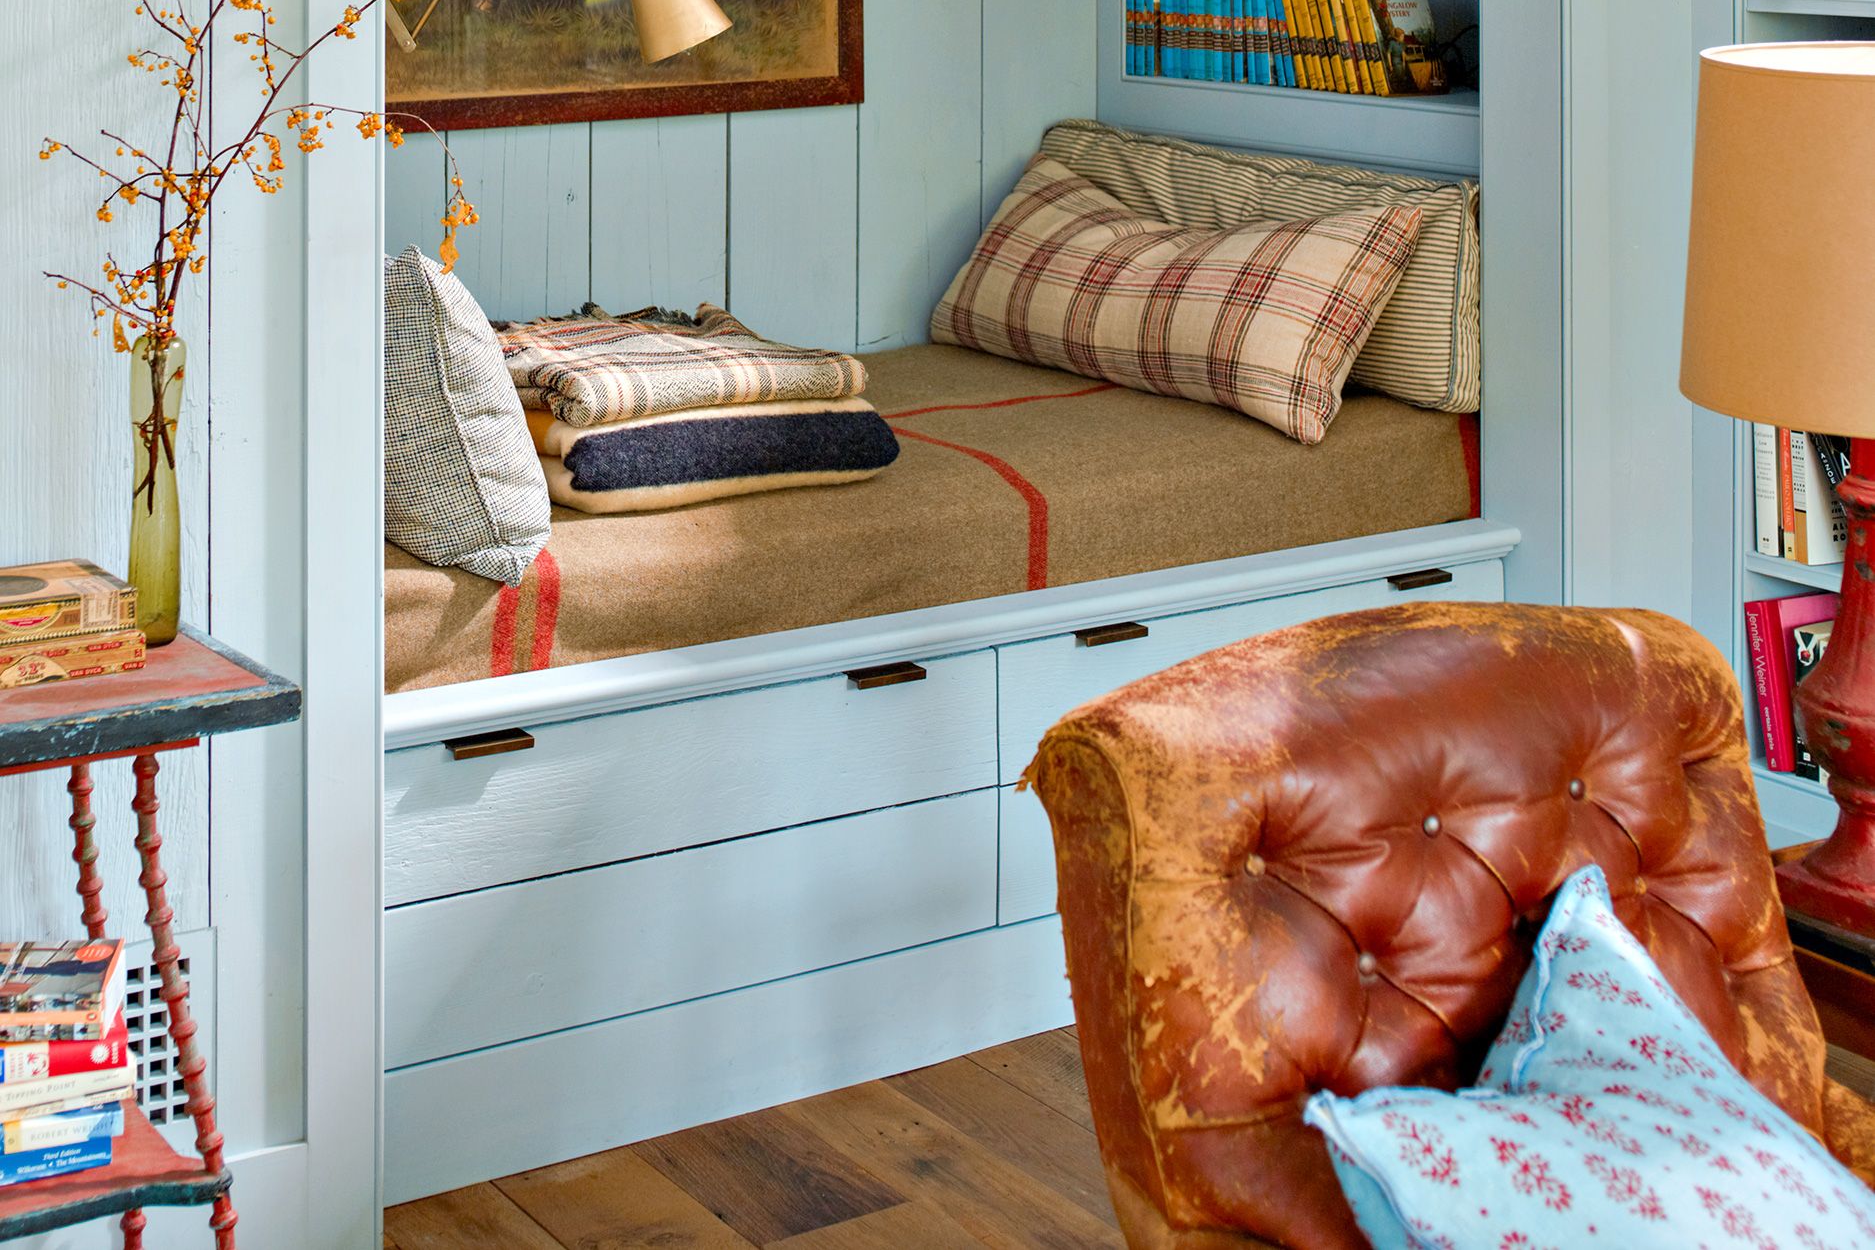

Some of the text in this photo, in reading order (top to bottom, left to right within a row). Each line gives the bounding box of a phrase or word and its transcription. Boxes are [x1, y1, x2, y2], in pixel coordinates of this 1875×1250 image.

[1747, 611, 1774, 751] Jennifer Weiner certain girls
[5, 1080, 76, 1101] TIPPING POINT
[31, 1129, 68, 1142] ROBERT
[60, 1148, 81, 1158] Edition
